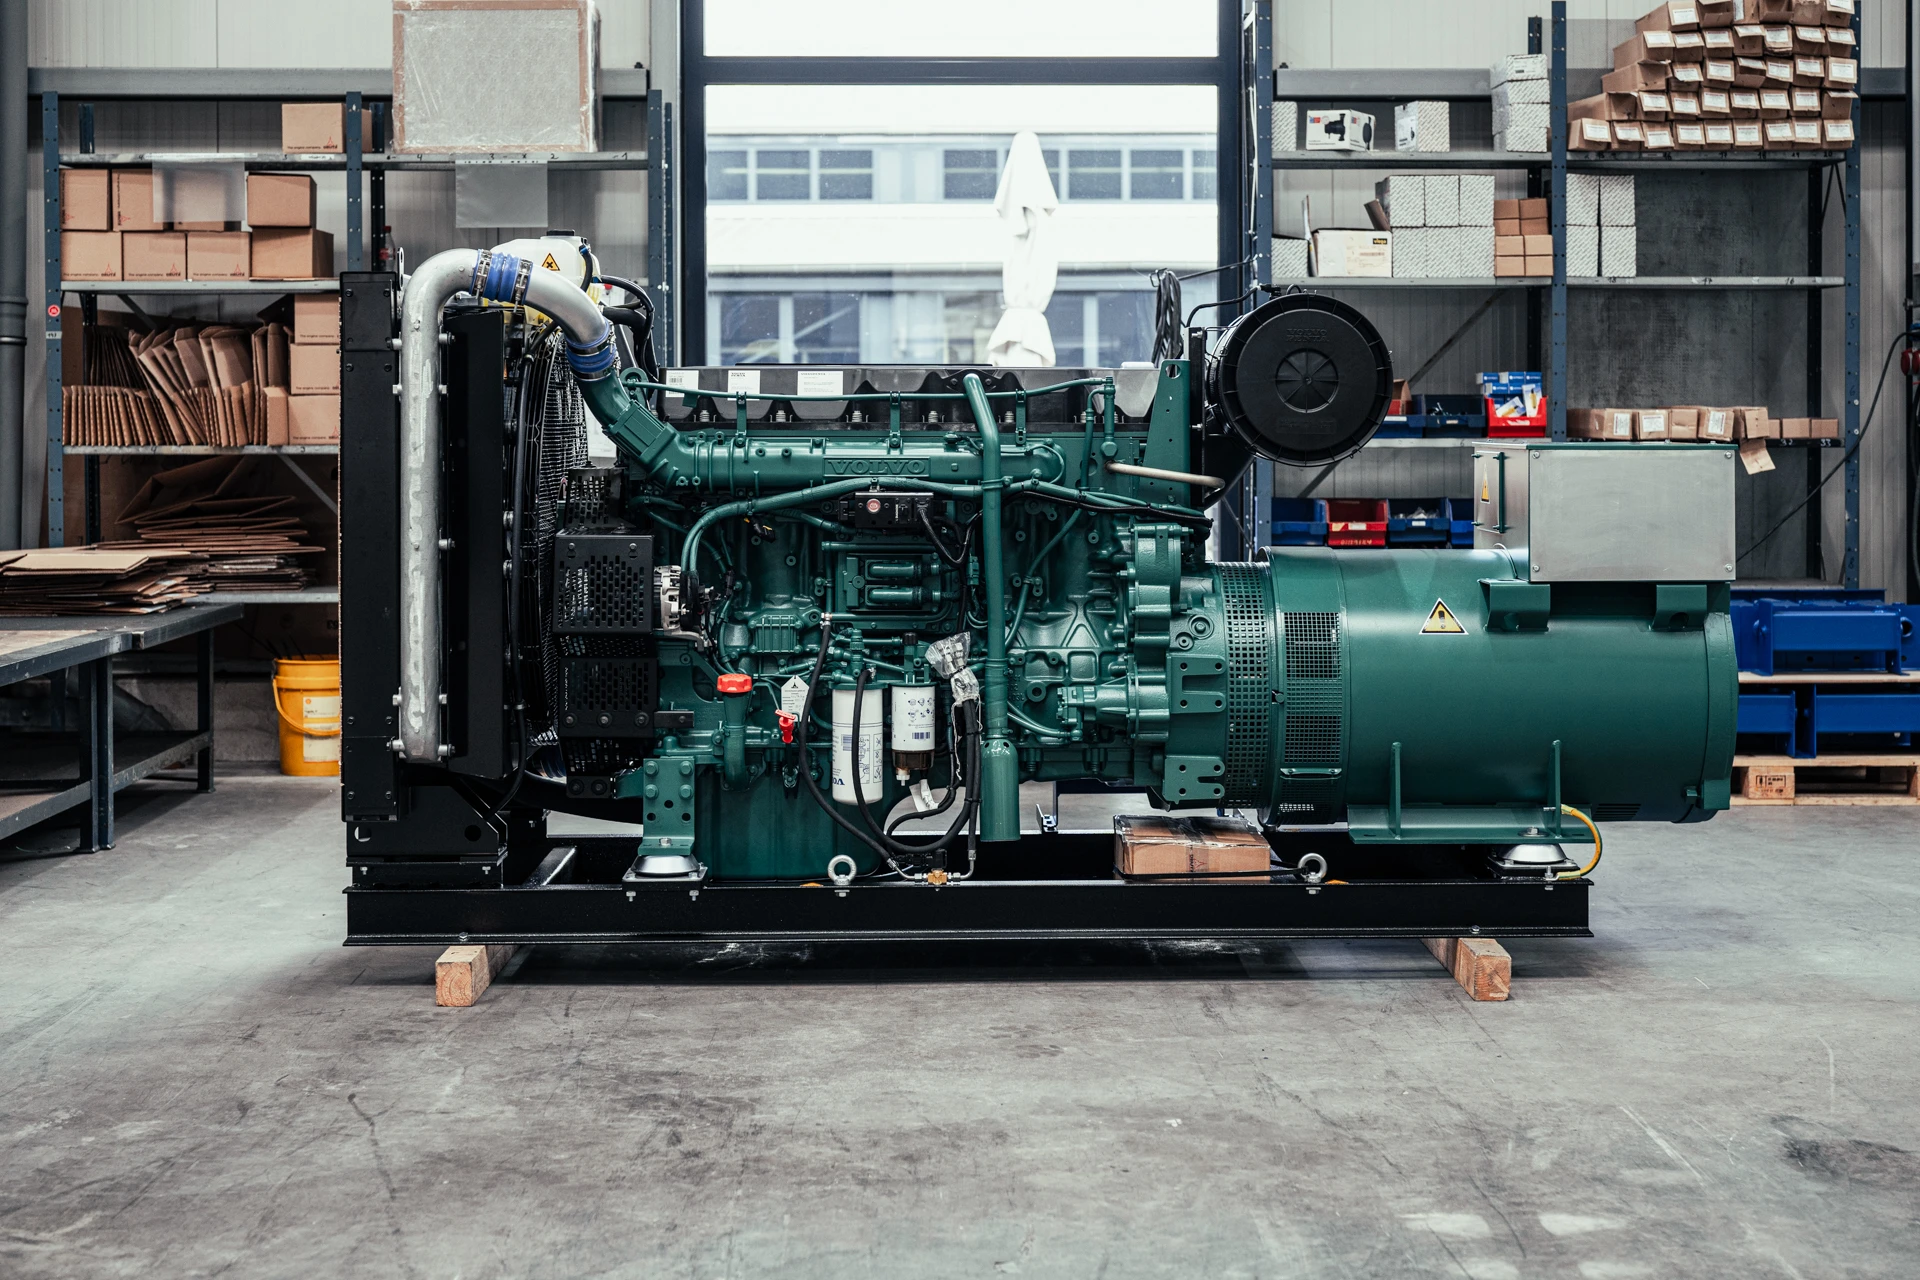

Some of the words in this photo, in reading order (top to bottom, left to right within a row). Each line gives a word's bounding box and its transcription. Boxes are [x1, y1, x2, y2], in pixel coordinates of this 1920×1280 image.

[1849, 230, 1854, 240] 4
[1849, 319, 1855, 329] 5
[1850, 384, 1856, 396] 6
[1820, 438, 1831, 446] 33
[828, 459, 926, 475] VOLVO
[1849, 470, 1856, 482] 7
[1848, 556, 1854, 569] 8
